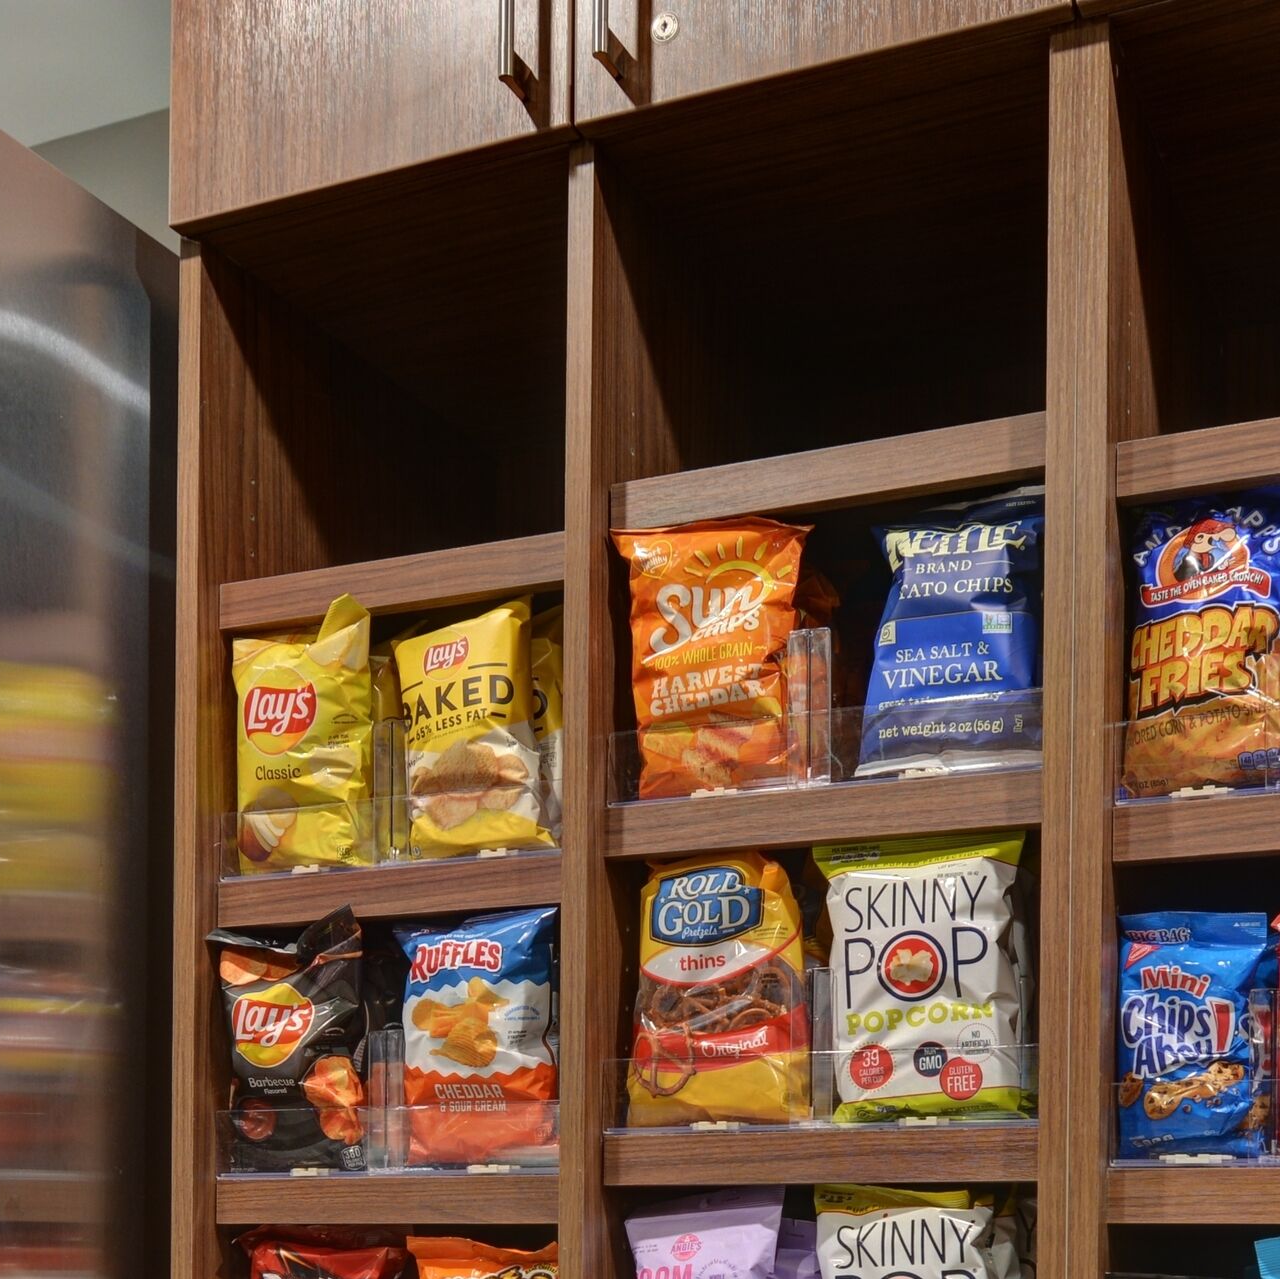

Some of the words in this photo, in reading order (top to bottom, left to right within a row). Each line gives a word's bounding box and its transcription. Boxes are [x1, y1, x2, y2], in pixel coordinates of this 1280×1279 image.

[916, 560, 972, 574] BRAND
[1151, 589, 1169, 602] TASTE
[1170, 586, 1182, 597] THE
[1183, 580, 1202, 594] OVEN
[1202, 573, 1228, 587] BAKED
[1229, 573, 1264, 585] CRUNCH!
[895, 648, 926, 664] SEA
[930, 643, 972, 660] SALT
[978, 641, 990, 655] &
[1130, 605, 1278, 671] CHEDDAR
[654, 655, 679, 669] 100%
[683, 646, 717, 664] WHOLE
[720, 642, 753, 659] GRAIN
[652, 663, 764, 699] HARVEST
[883, 660, 1003, 690] VINEGAR
[1139, 651, 1251, 711] FRIES
[402, 674, 514, 730] BAKED
[650, 680, 765, 716] CHEDDAR
[415, 725, 432, 741] 65%
[435, 715, 462, 732] LESS
[466, 709, 487, 725] FAT
[879, 726, 898, 739] net
[902, 722, 947, 738] weight
[255, 764, 301, 781] Classic
[668, 872, 742, 900] ROLD
[658, 896, 750, 936] GOLD
[844, 875, 987, 933] SKINNY
[681, 926, 718, 939] Pretzels
[410, 940, 502, 981] RUFFLES
[680, 954, 726, 971] thins
[844, 927, 988, 1009] POP
[1142, 967, 1211, 998] Mini
[235, 1000, 306, 1047] Lay's
[846, 1001, 994, 1036] POPCORN
[919, 1055, 942, 1070] GMO
[948, 1065, 973, 1075] GLUTEN
[248, 1076, 296, 1089] Barbecue
[434, 1083, 505, 1099] CHEDDAR
[947, 1075, 977, 1093] FREE
[440, 1102, 446, 1112] &
[449, 1102, 472, 1112] SOUR
[475, 1100, 507, 1112] CREAM
[836, 1217, 975, 1269] SKINNY
